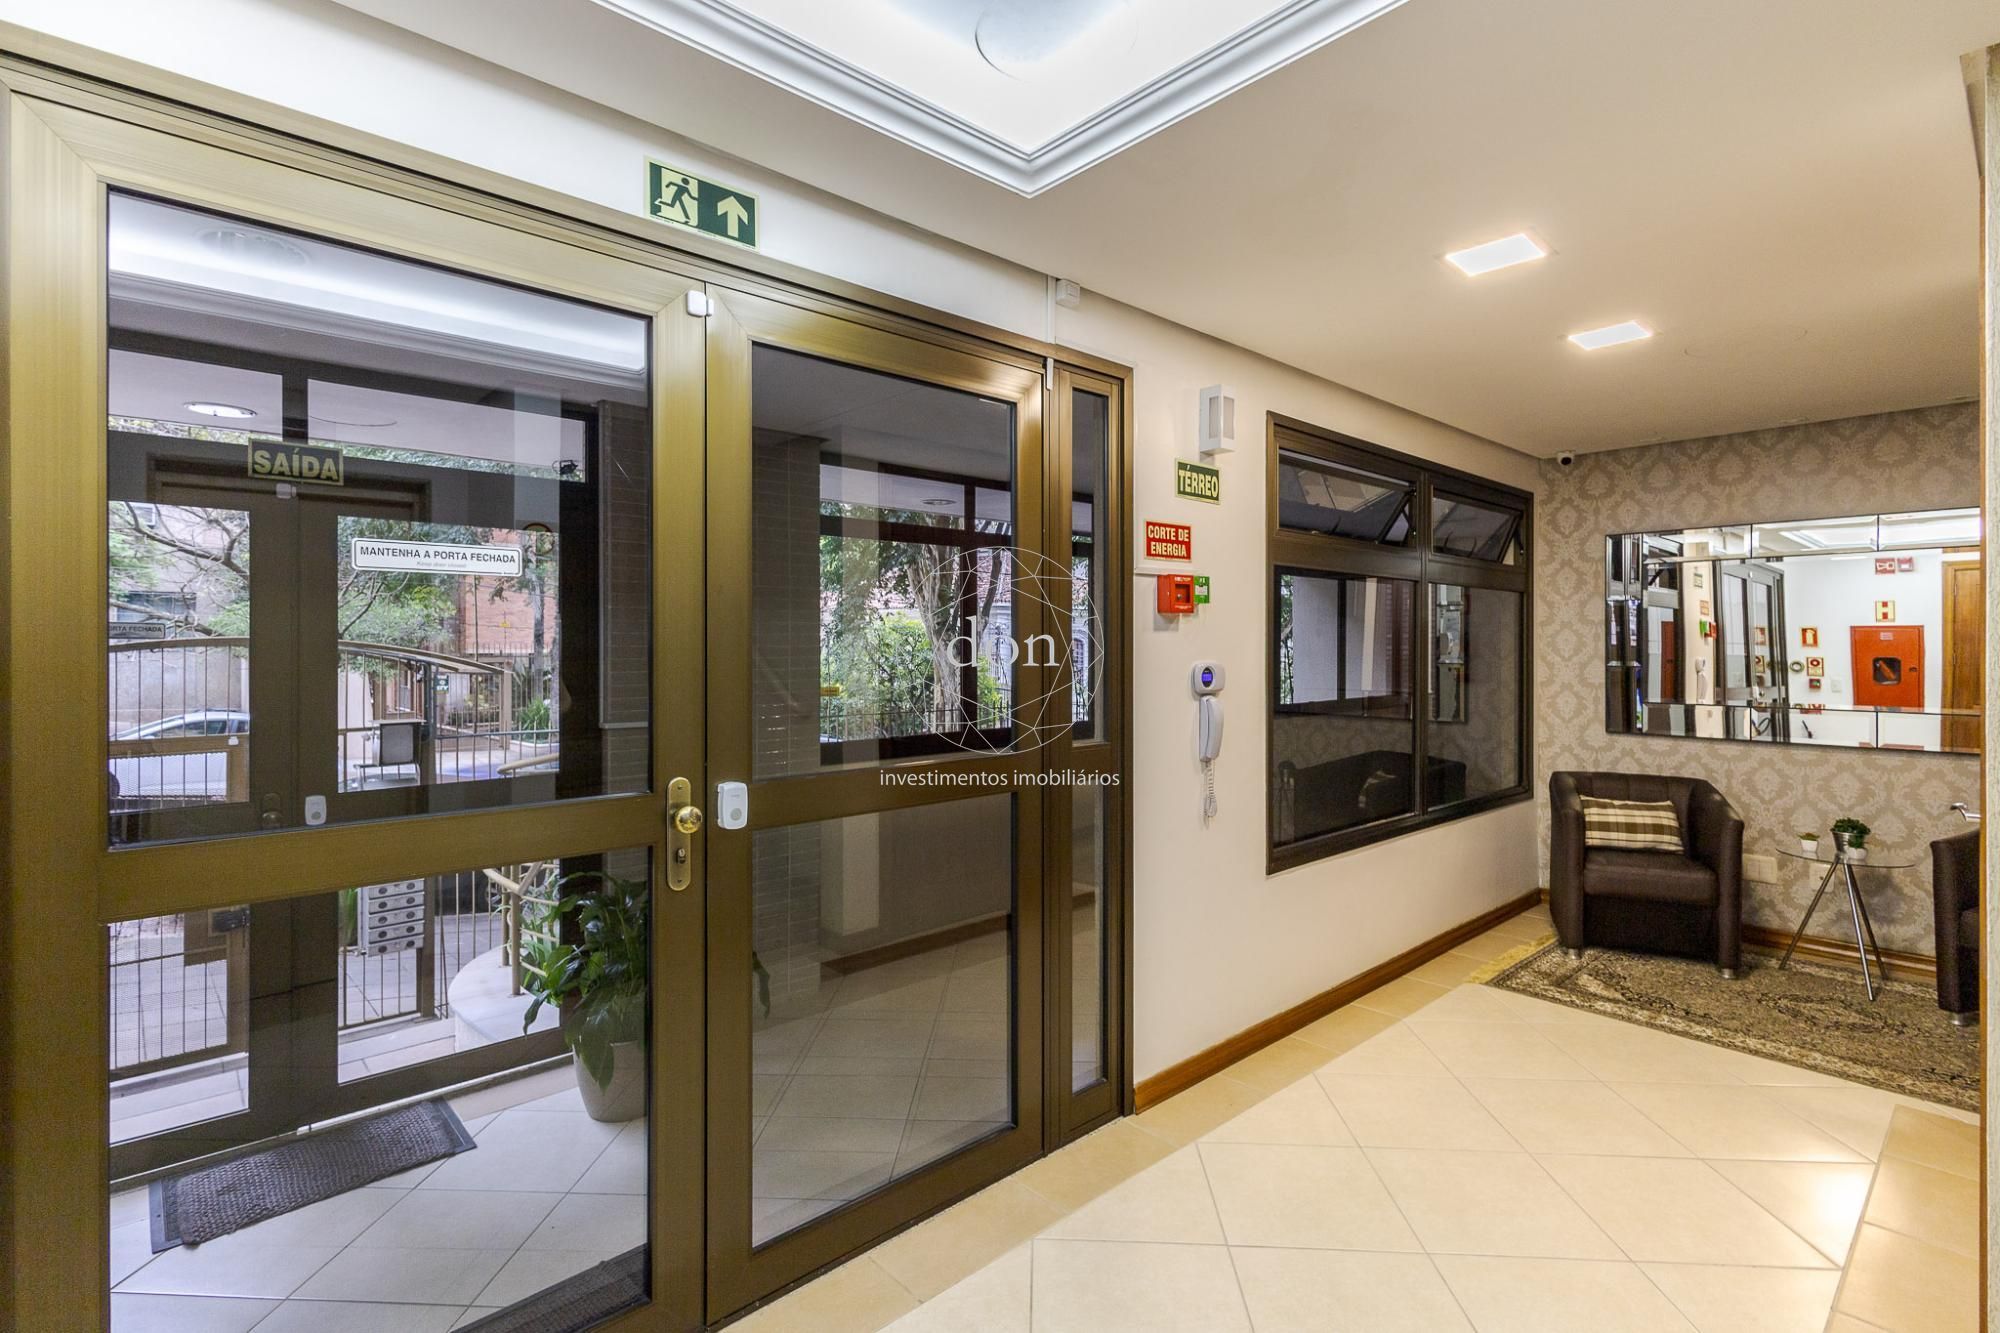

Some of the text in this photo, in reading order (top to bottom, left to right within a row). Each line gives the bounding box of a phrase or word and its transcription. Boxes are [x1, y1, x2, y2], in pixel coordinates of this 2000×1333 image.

[254, 447, 338, 480] SAÍDA
[1178, 464, 1219, 498] TÉRREO
[1148, 525, 1189, 542] CORTE DE
[360, 546, 516, 564] MANTENHA A PORTA FECHADA
[1151, 541, 1187, 557] ENERGIA
